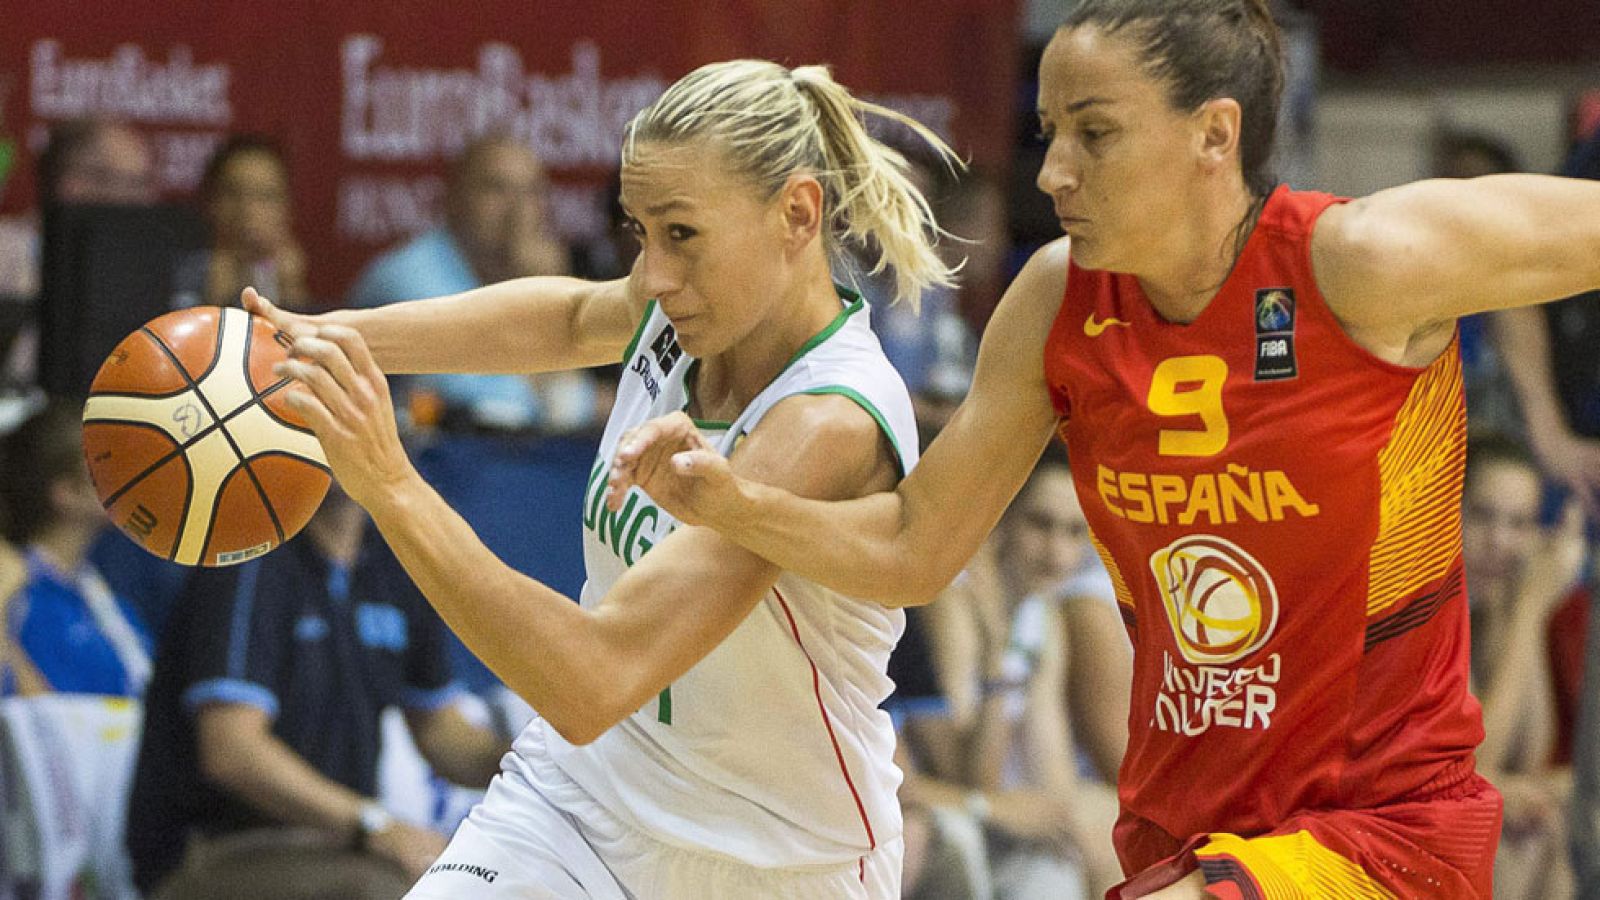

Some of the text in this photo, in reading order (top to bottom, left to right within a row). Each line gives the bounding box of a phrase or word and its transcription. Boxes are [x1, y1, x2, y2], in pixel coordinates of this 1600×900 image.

[1261, 339, 1288, 357] FIBA
[1147, 354, 1229, 458] 9
[1097, 463, 1320, 525] ESPAÑA
